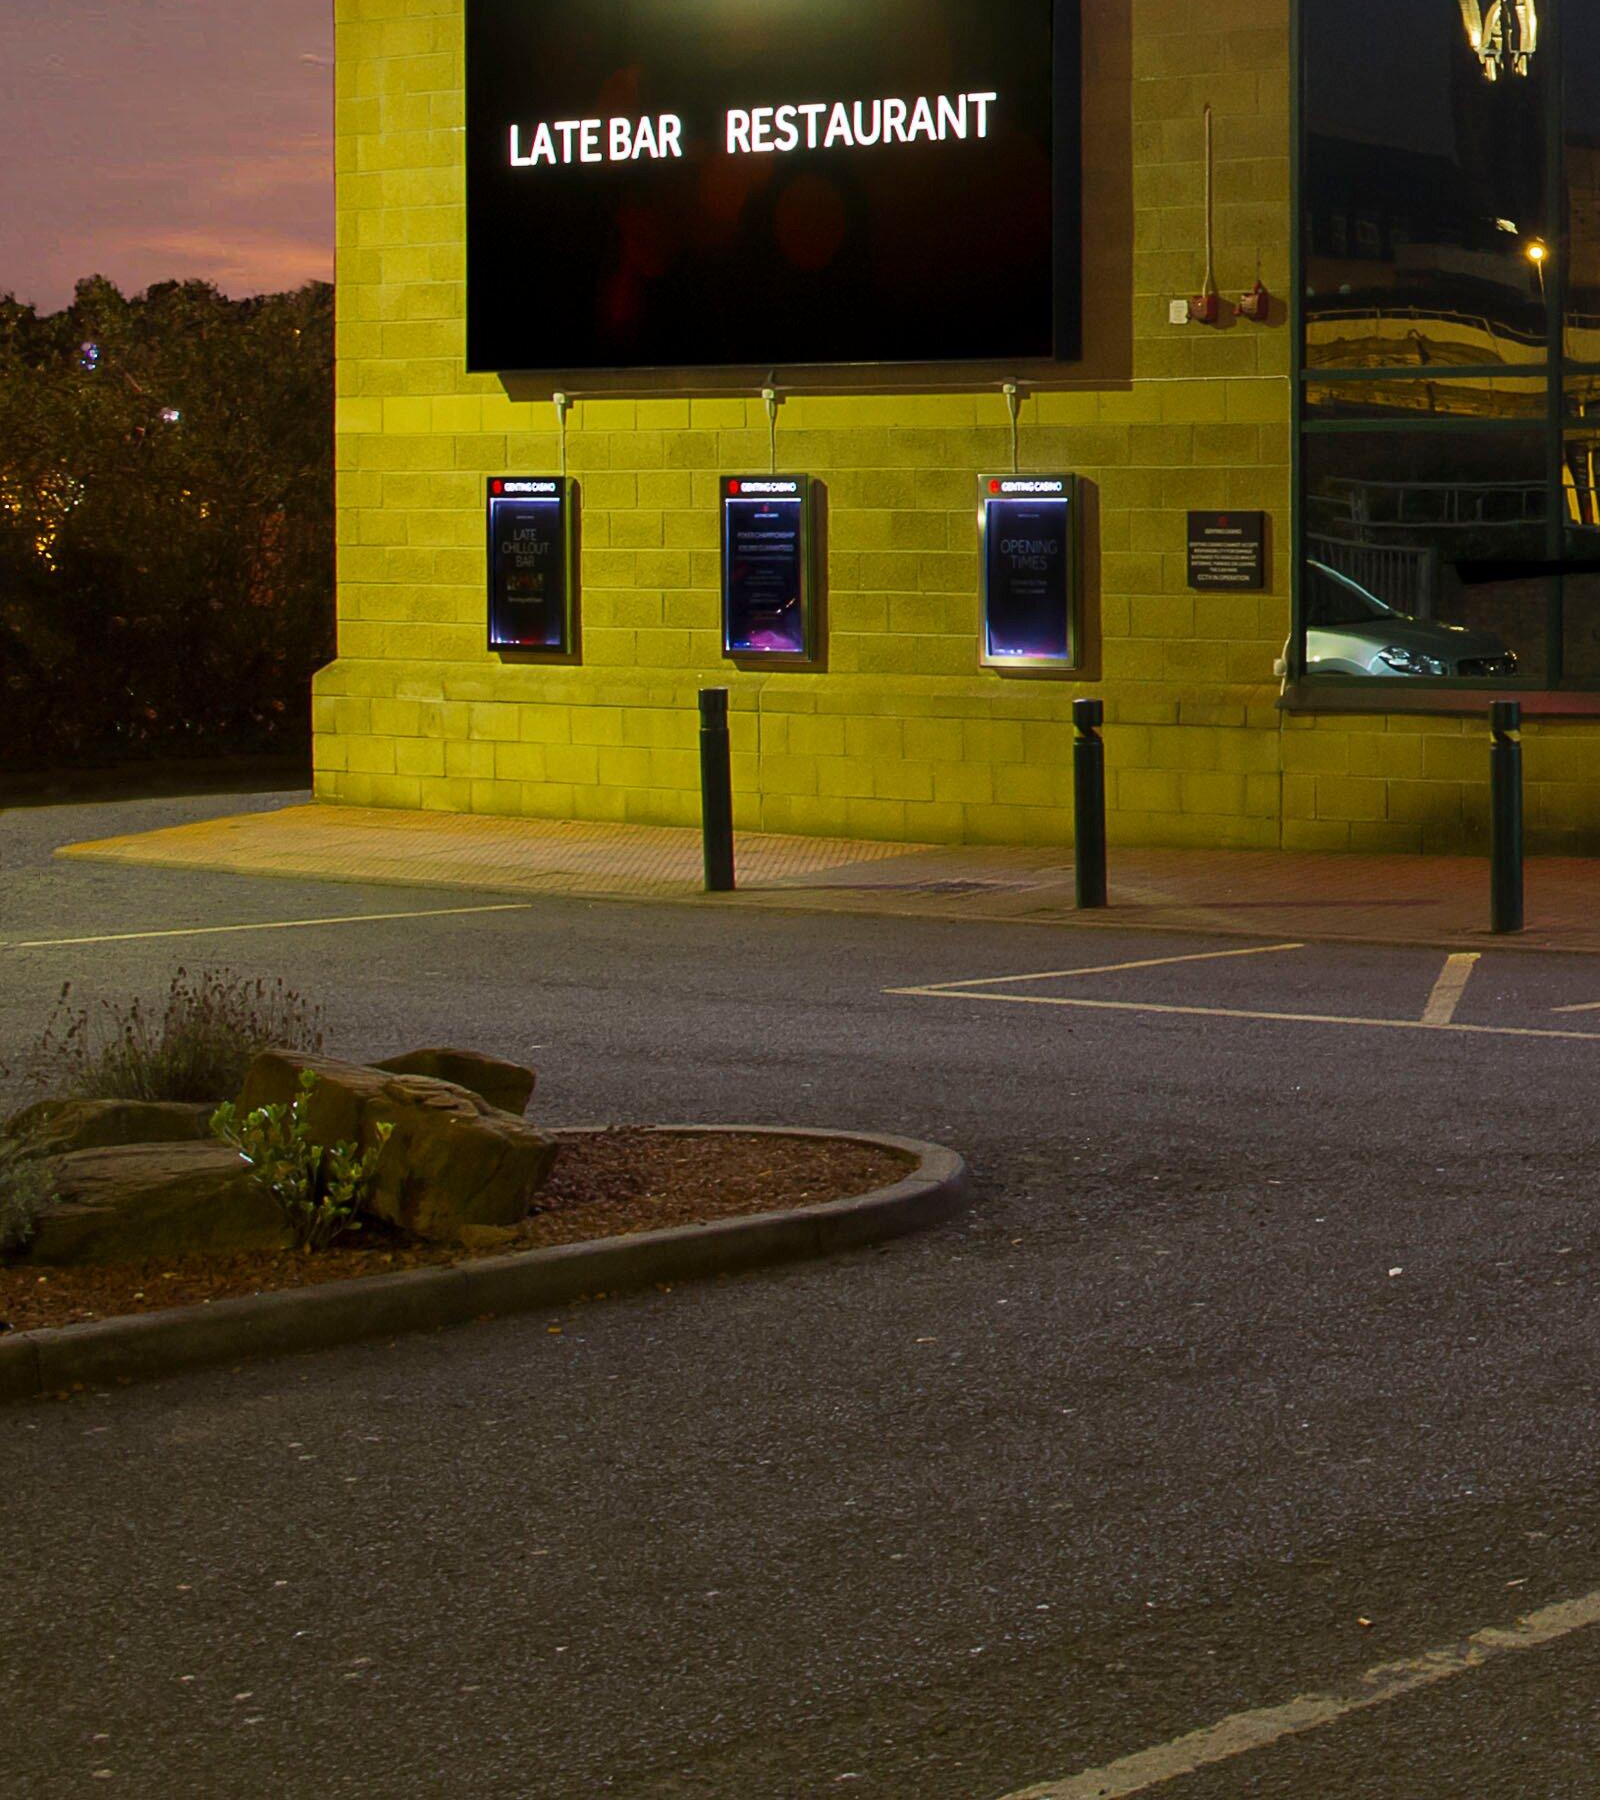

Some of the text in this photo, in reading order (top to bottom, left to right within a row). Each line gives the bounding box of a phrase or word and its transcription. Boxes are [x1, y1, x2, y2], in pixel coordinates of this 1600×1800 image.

[509, 90, 998, 168] LATE BAR RESTAURANT
[512, 528, 537, 541] LATE
[502, 541, 550, 554] CHILLOUT
[1000, 538, 1058, 555] OPENING
[515, 554, 536, 568] BAR
[1010, 554, 1048, 570] TIMES
